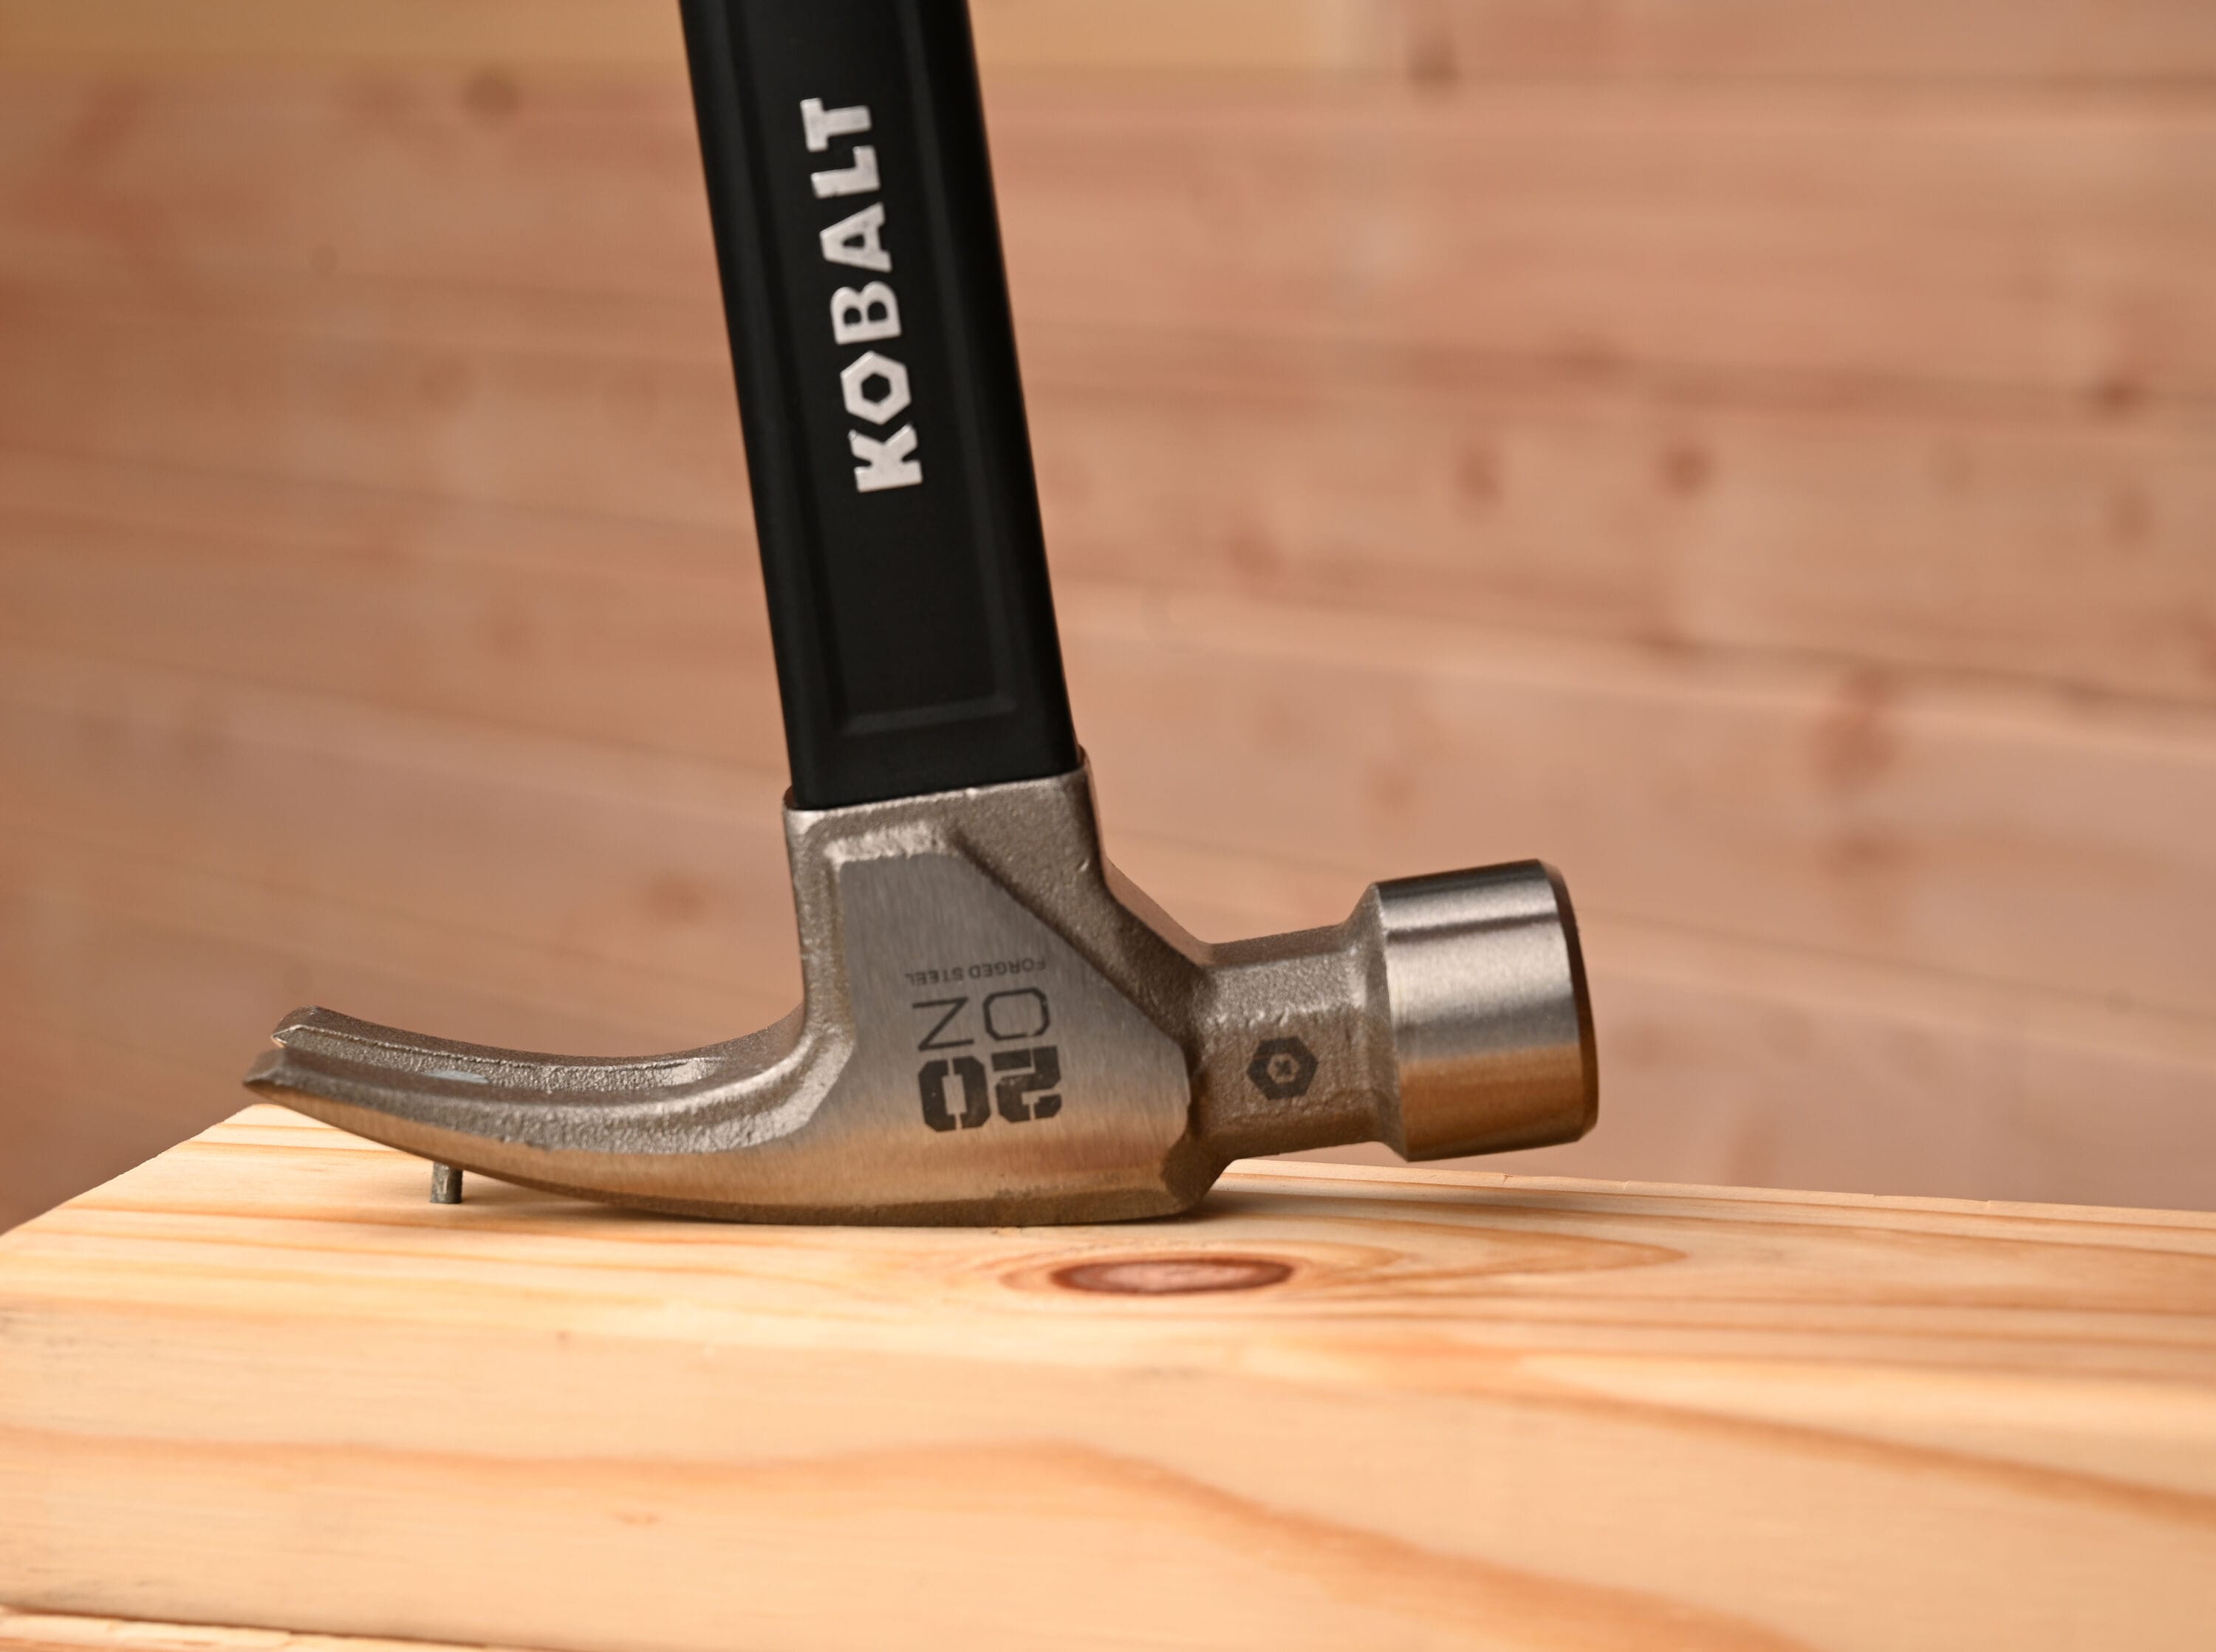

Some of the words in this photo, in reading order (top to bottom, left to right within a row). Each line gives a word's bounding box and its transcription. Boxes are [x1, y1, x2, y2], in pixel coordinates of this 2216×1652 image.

[800, 97, 922, 493] KOBALT
[904, 967, 963, 986] STEEL
[968, 959, 1046, 978] FORGED
[912, 987, 1050, 1052] OZ
[918, 1046, 1061, 1132] 20
